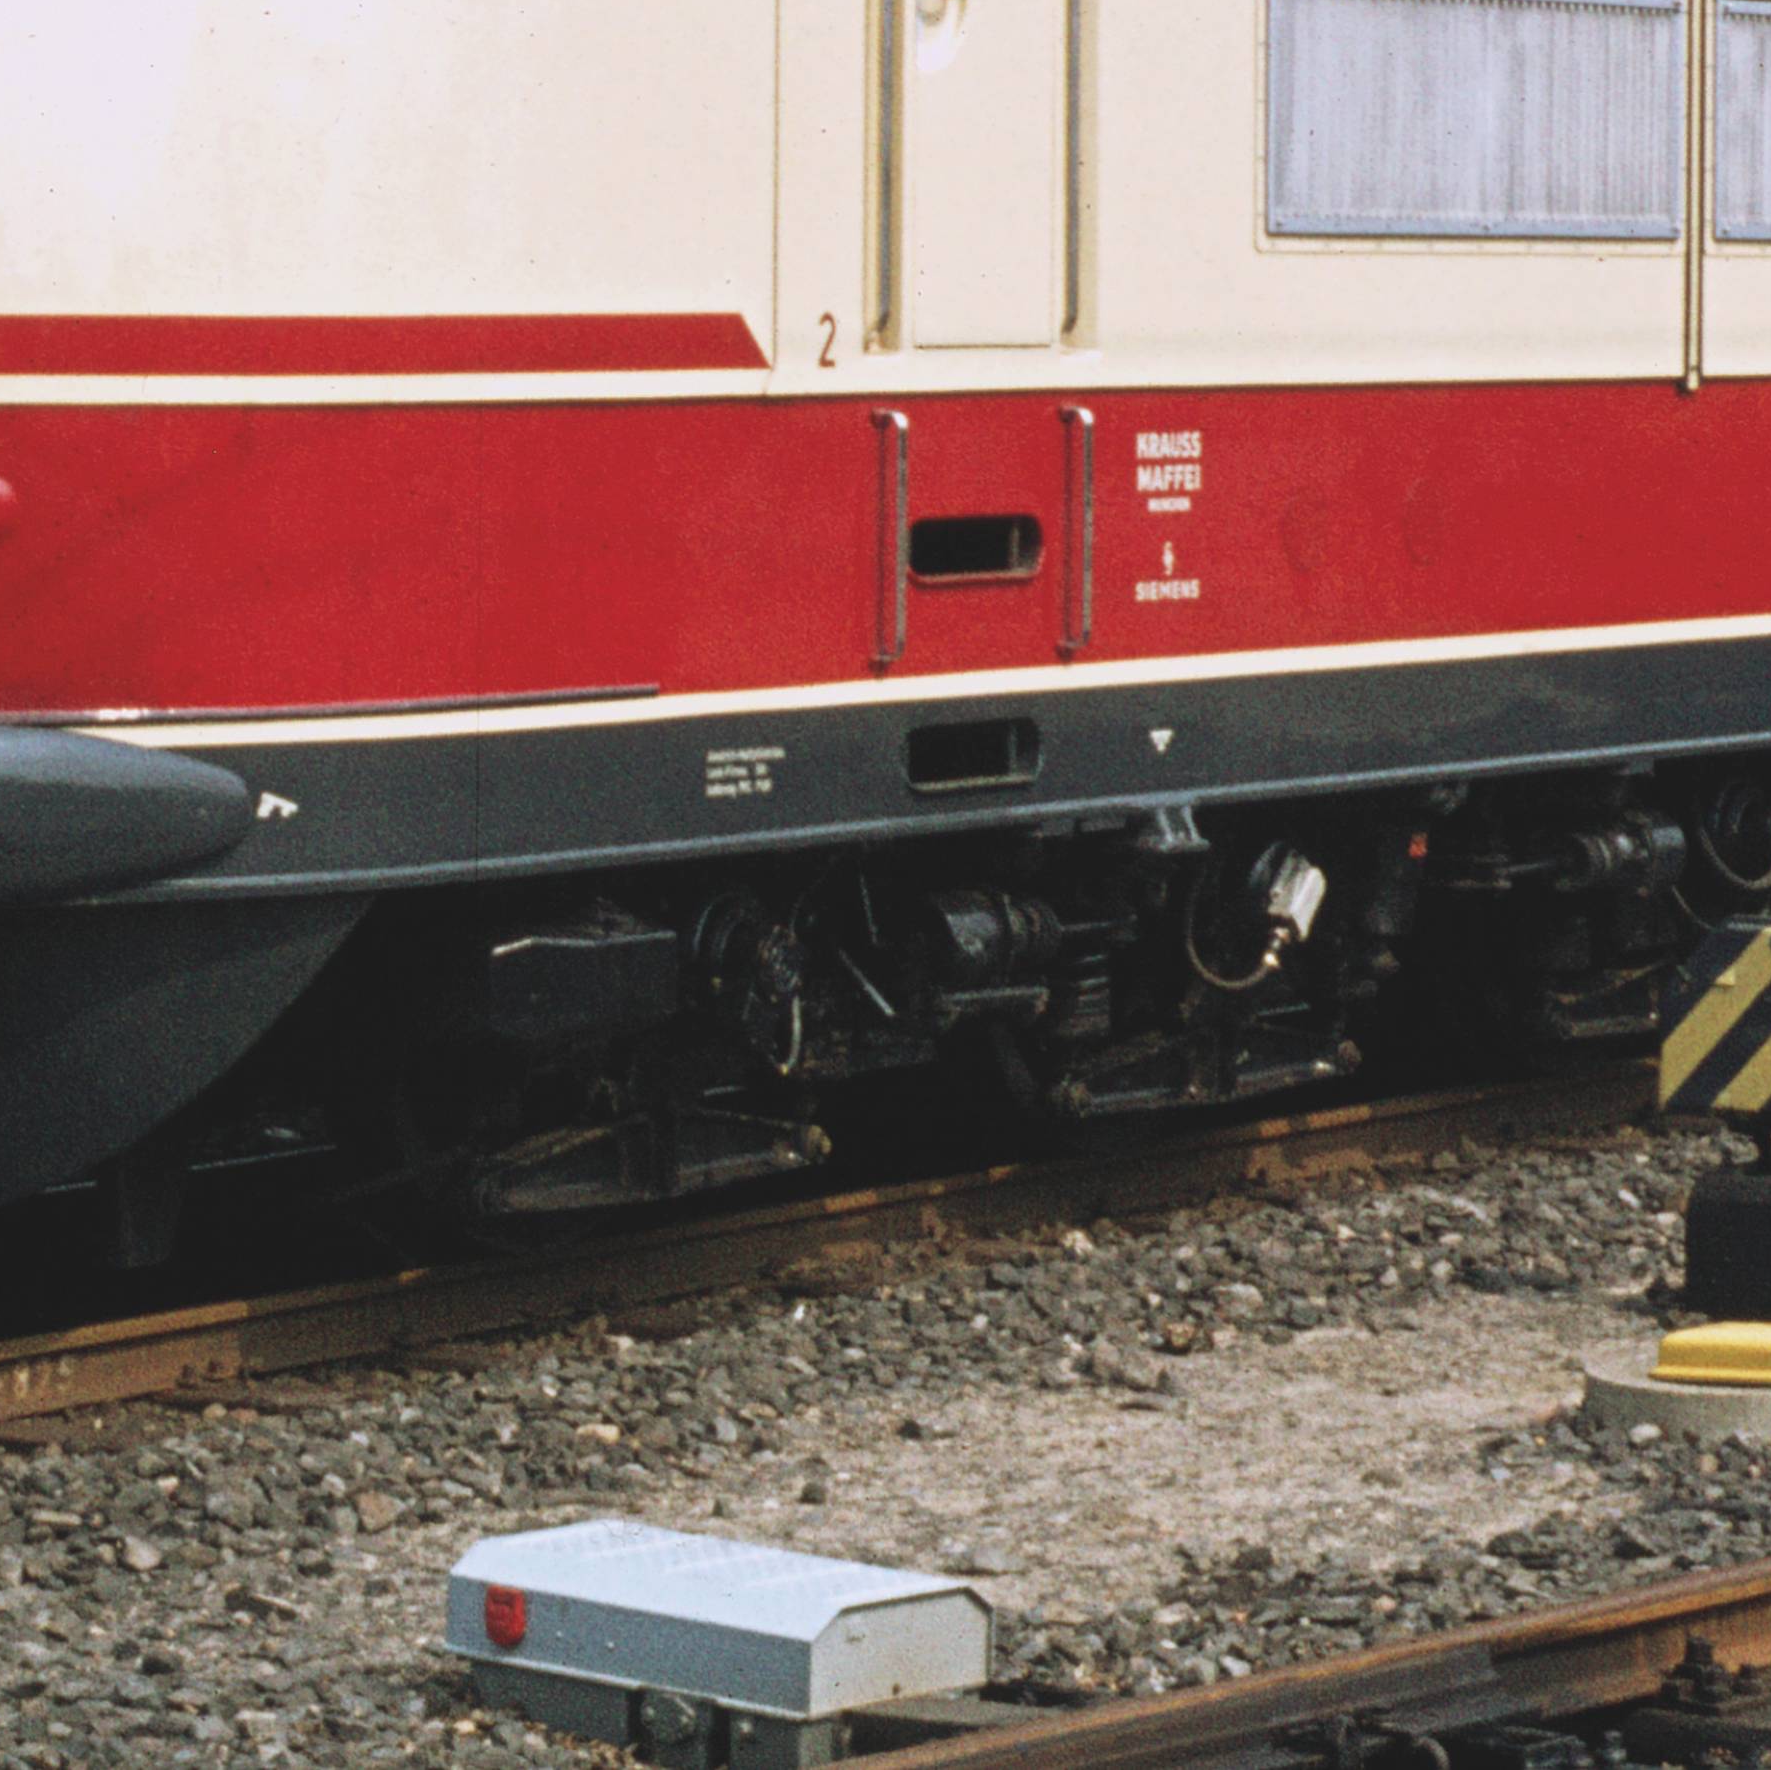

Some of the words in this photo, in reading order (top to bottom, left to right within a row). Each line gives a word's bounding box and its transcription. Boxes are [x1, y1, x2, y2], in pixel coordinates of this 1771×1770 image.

[818, 313, 836, 367] 2
[1136, 431, 1202, 459] KRAUSS
[1136, 463, 1202, 491] MAFFEI
[1135, 579, 1200, 602] SIEMENS
